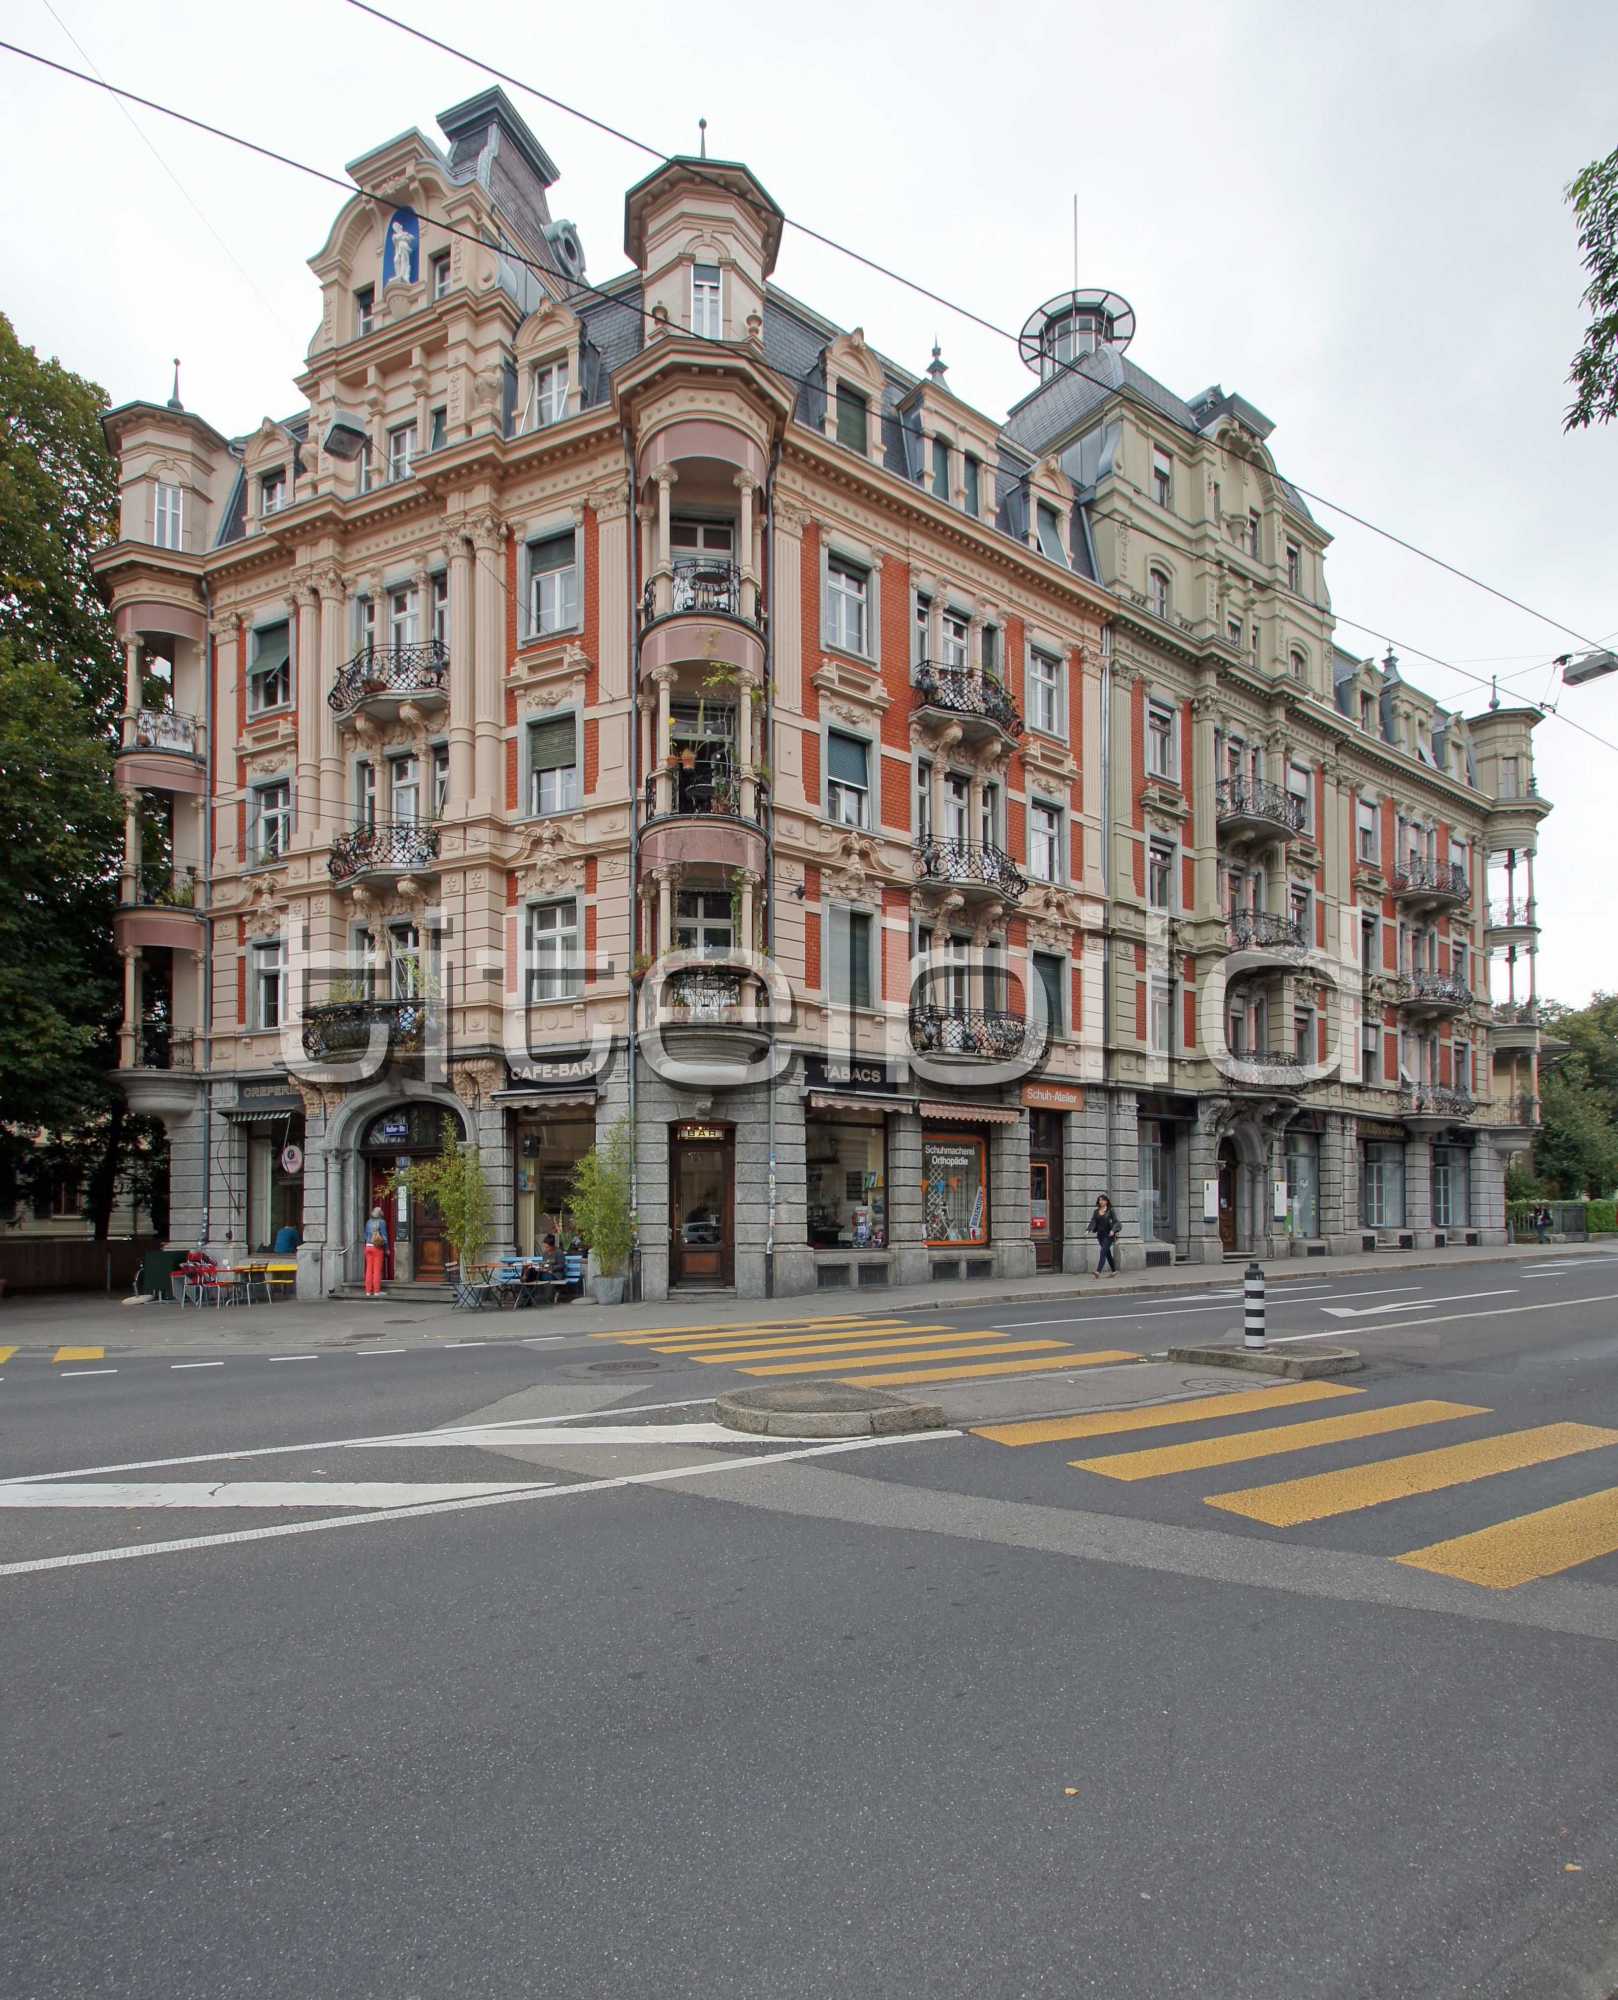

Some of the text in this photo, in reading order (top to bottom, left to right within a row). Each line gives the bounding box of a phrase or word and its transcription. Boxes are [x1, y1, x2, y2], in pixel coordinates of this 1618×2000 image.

[820, 1064, 882, 1083] TABACS
[1026, 1087, 1078, 1105] Schuh-Atelier
[687, 1129, 716, 1137] BAR
[925, 1144, 976, 1156] Schuhmacherei
